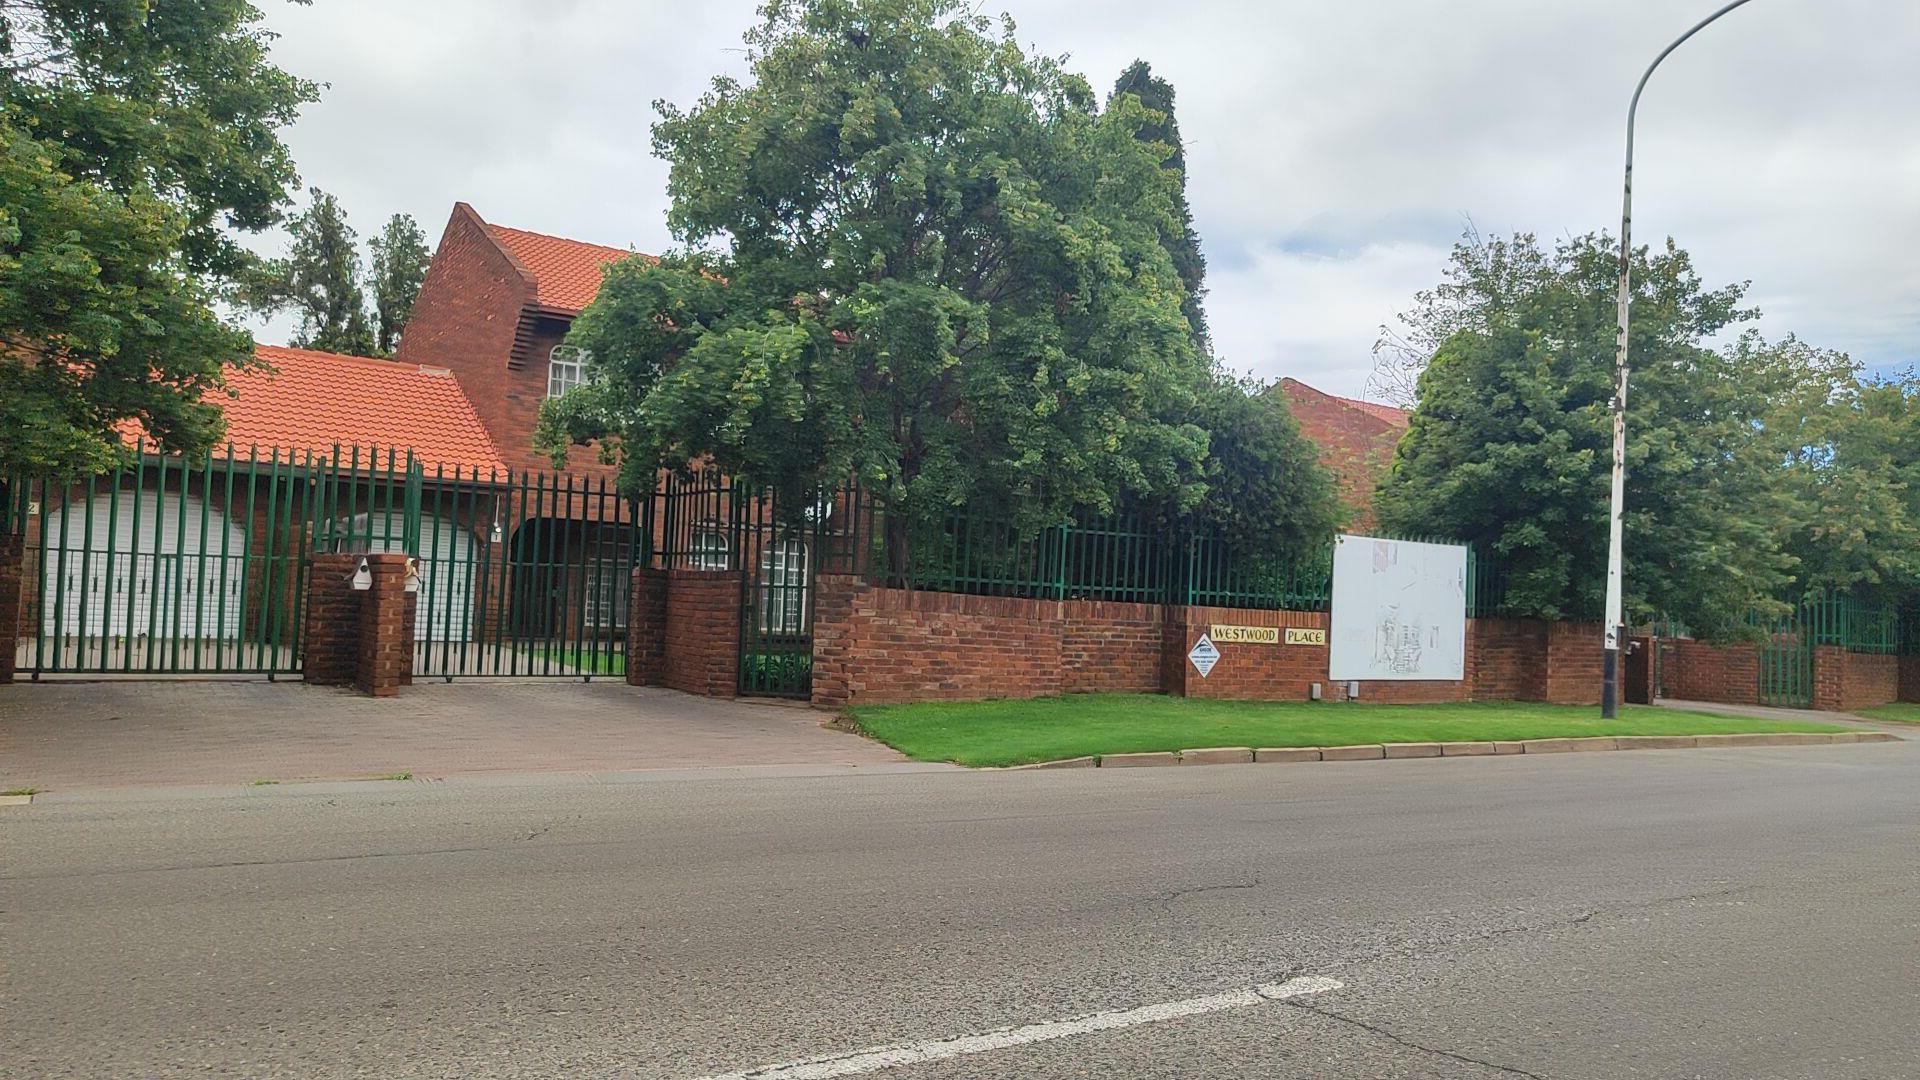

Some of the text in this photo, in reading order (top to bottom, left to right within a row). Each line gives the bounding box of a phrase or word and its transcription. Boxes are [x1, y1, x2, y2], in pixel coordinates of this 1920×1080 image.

[29, 504, 35, 513] 2
[1214, 628, 1322, 642] WESTWOOD PLACE
